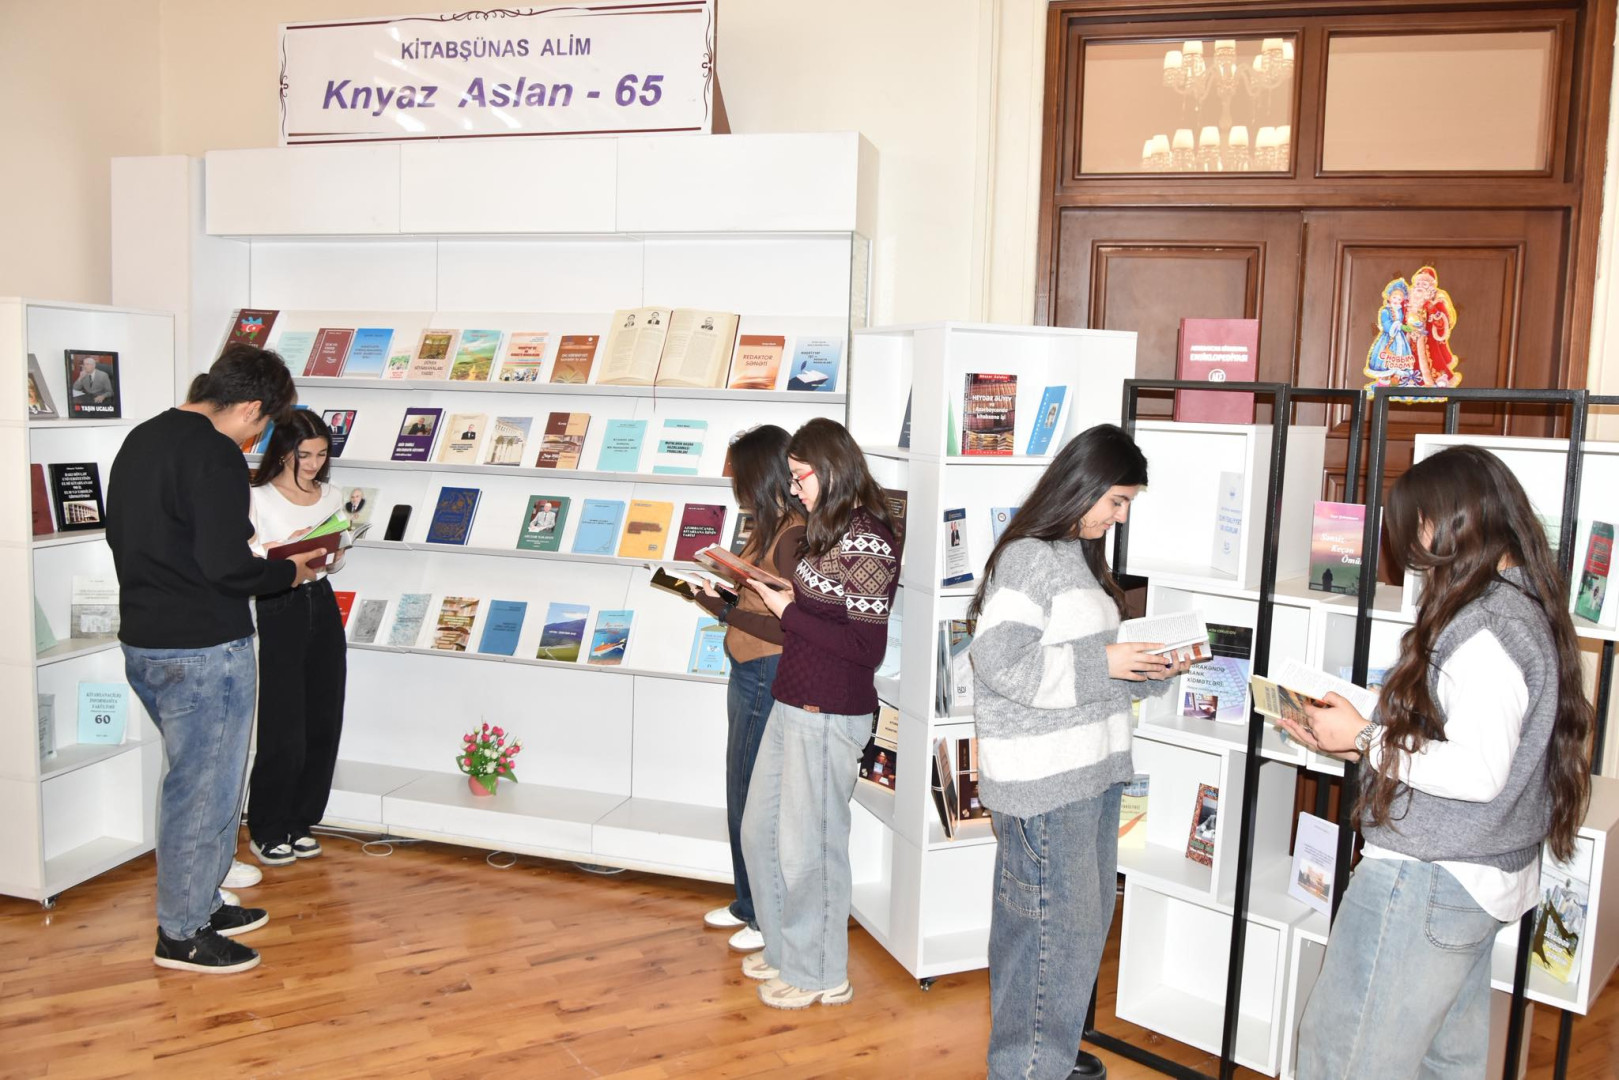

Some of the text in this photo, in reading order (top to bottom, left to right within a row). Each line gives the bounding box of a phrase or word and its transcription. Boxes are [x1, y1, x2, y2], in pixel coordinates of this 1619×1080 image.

[400, 34, 592, 62] KİTABŞÜNAS ALİM
[322, 74, 664, 117] Knyaz Aslan - 65
[1340, 554, 1362, 565] Ömü
[95, 714, 111, 724] 60
